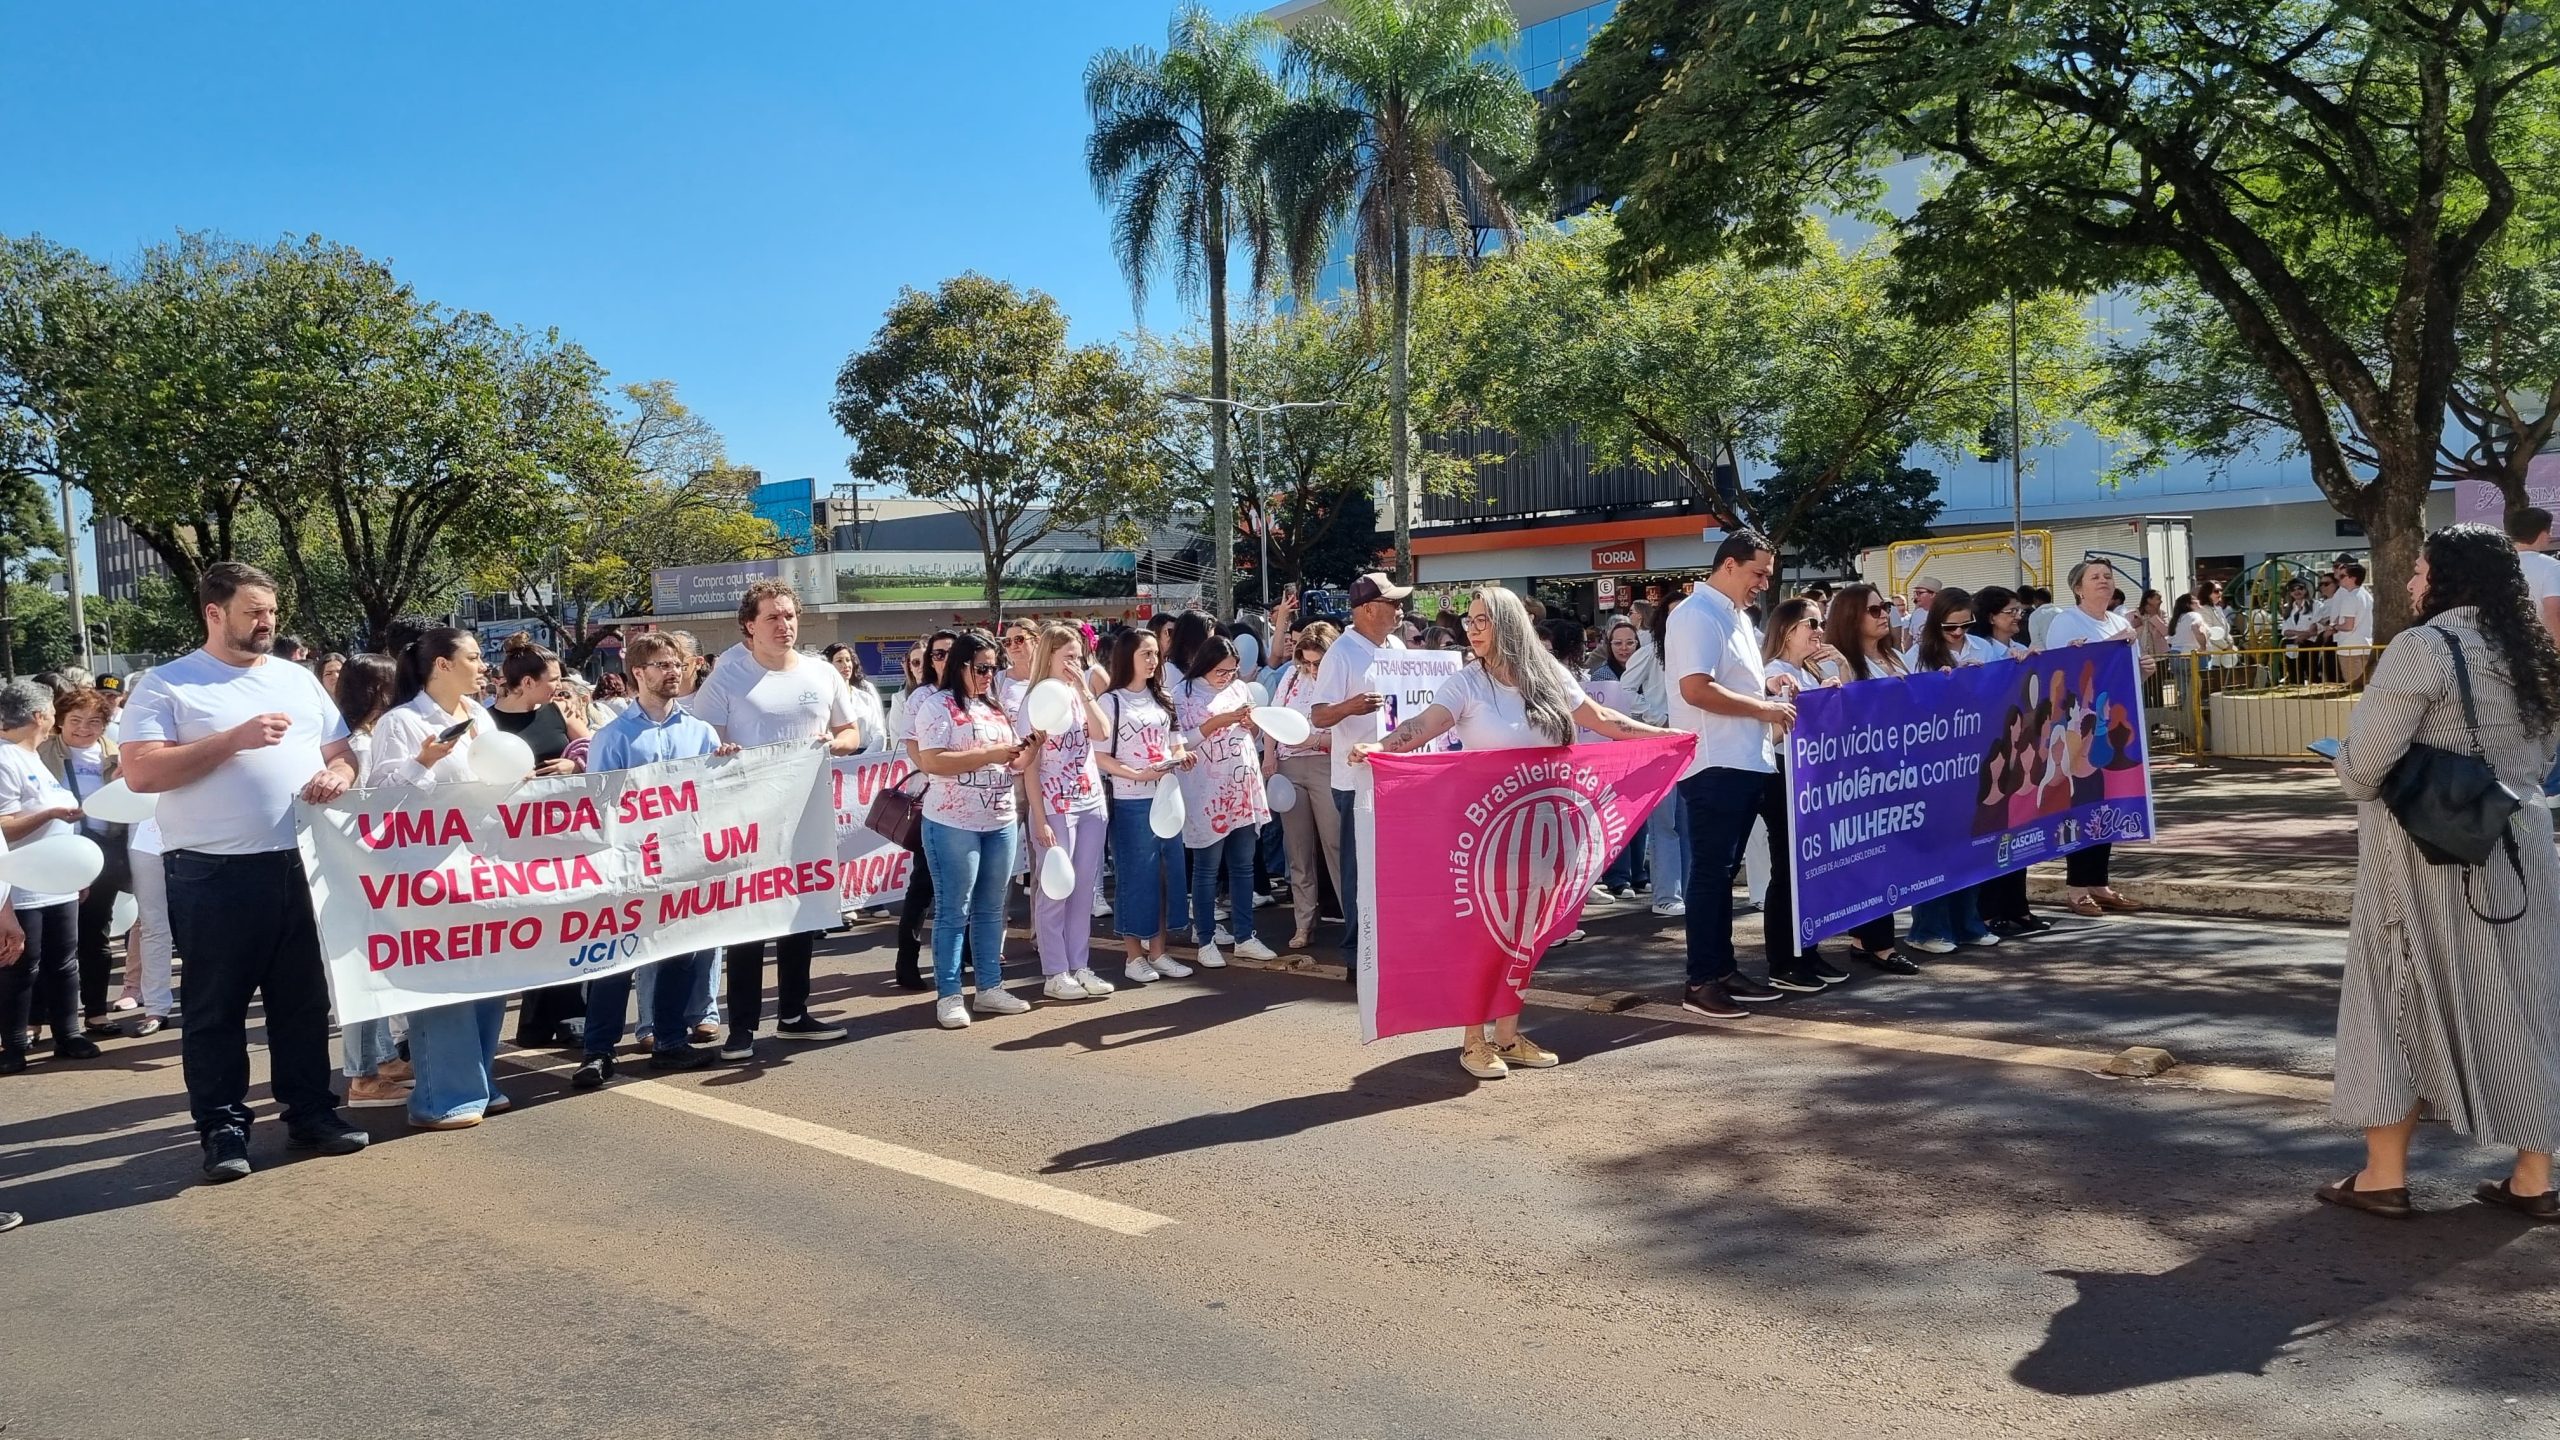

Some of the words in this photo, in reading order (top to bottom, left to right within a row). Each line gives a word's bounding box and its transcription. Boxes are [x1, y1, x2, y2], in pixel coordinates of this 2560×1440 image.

[693, 574, 724, 588] Compre
[726, 572, 744, 586] aqui
[1596, 550, 1636, 564] TORRA
[689, 590, 726, 606] produtos
[1406, 690, 1434, 705] LUTO
[1796, 733, 1836, 768] Pela
[1841, 724, 1883, 757] vida
[1887, 726, 1899, 749] e
[1903, 714, 1948, 756] pelo
[1953, 708, 1981, 738] fim
[1800, 782, 1822, 814] da
[1826, 760, 1918, 806] violência
[1921, 752, 1980, 786] contra
[358, 808, 474, 850] UMA
[497, 796, 601, 839] VIDA
[618, 780, 699, 824] SEM
[1450, 832, 1475, 918] União
[1464, 757, 1572, 827] Brasileira
[1574, 764, 1599, 791] de
[1802, 834, 1822, 861] as
[1829, 801, 1926, 853] MULHERES
[2010, 830, 2045, 850] CASCAVEL
[359, 853, 602, 909] VIOLÊNCIA
[640, 833, 662, 876] É
[703, 823, 758, 863] UM
[367, 917, 543, 972] DIREITO
[560, 899, 644, 943] DAS
[658, 859, 834, 924] MULHERES
[569, 939, 617, 966] JCI
